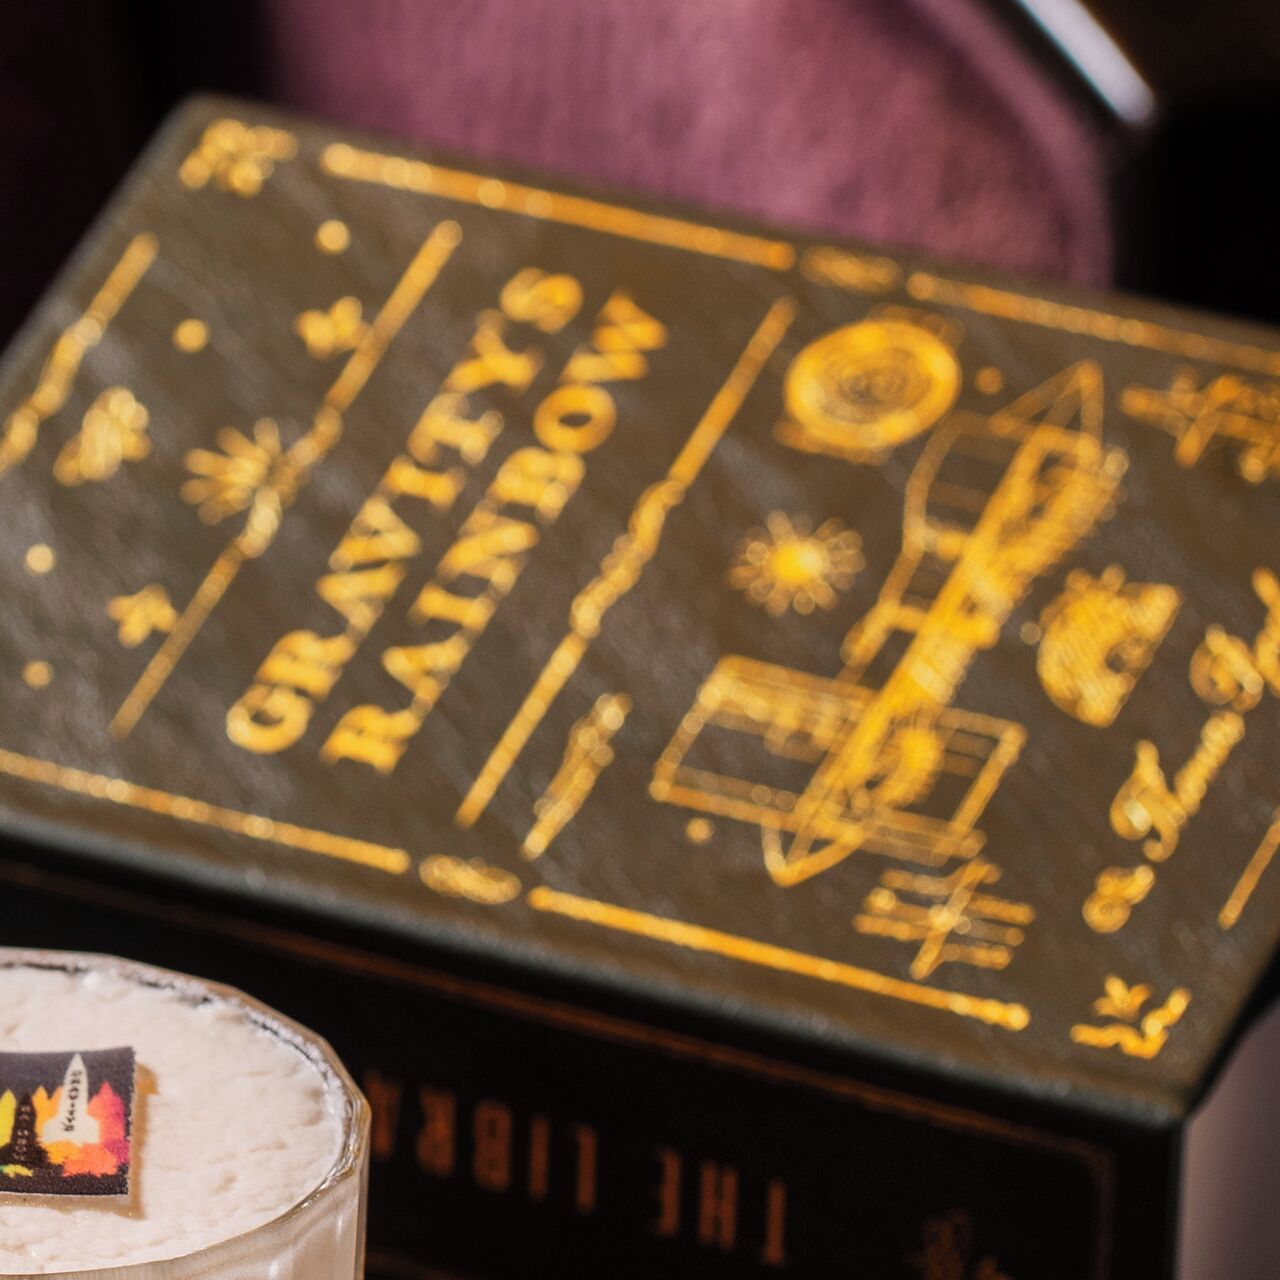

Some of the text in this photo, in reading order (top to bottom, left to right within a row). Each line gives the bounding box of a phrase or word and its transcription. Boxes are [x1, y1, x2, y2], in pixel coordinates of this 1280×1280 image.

[321, 291, 667, 774] RAINBOW
[365, 1068, 787, 1267] THE LIBRA
